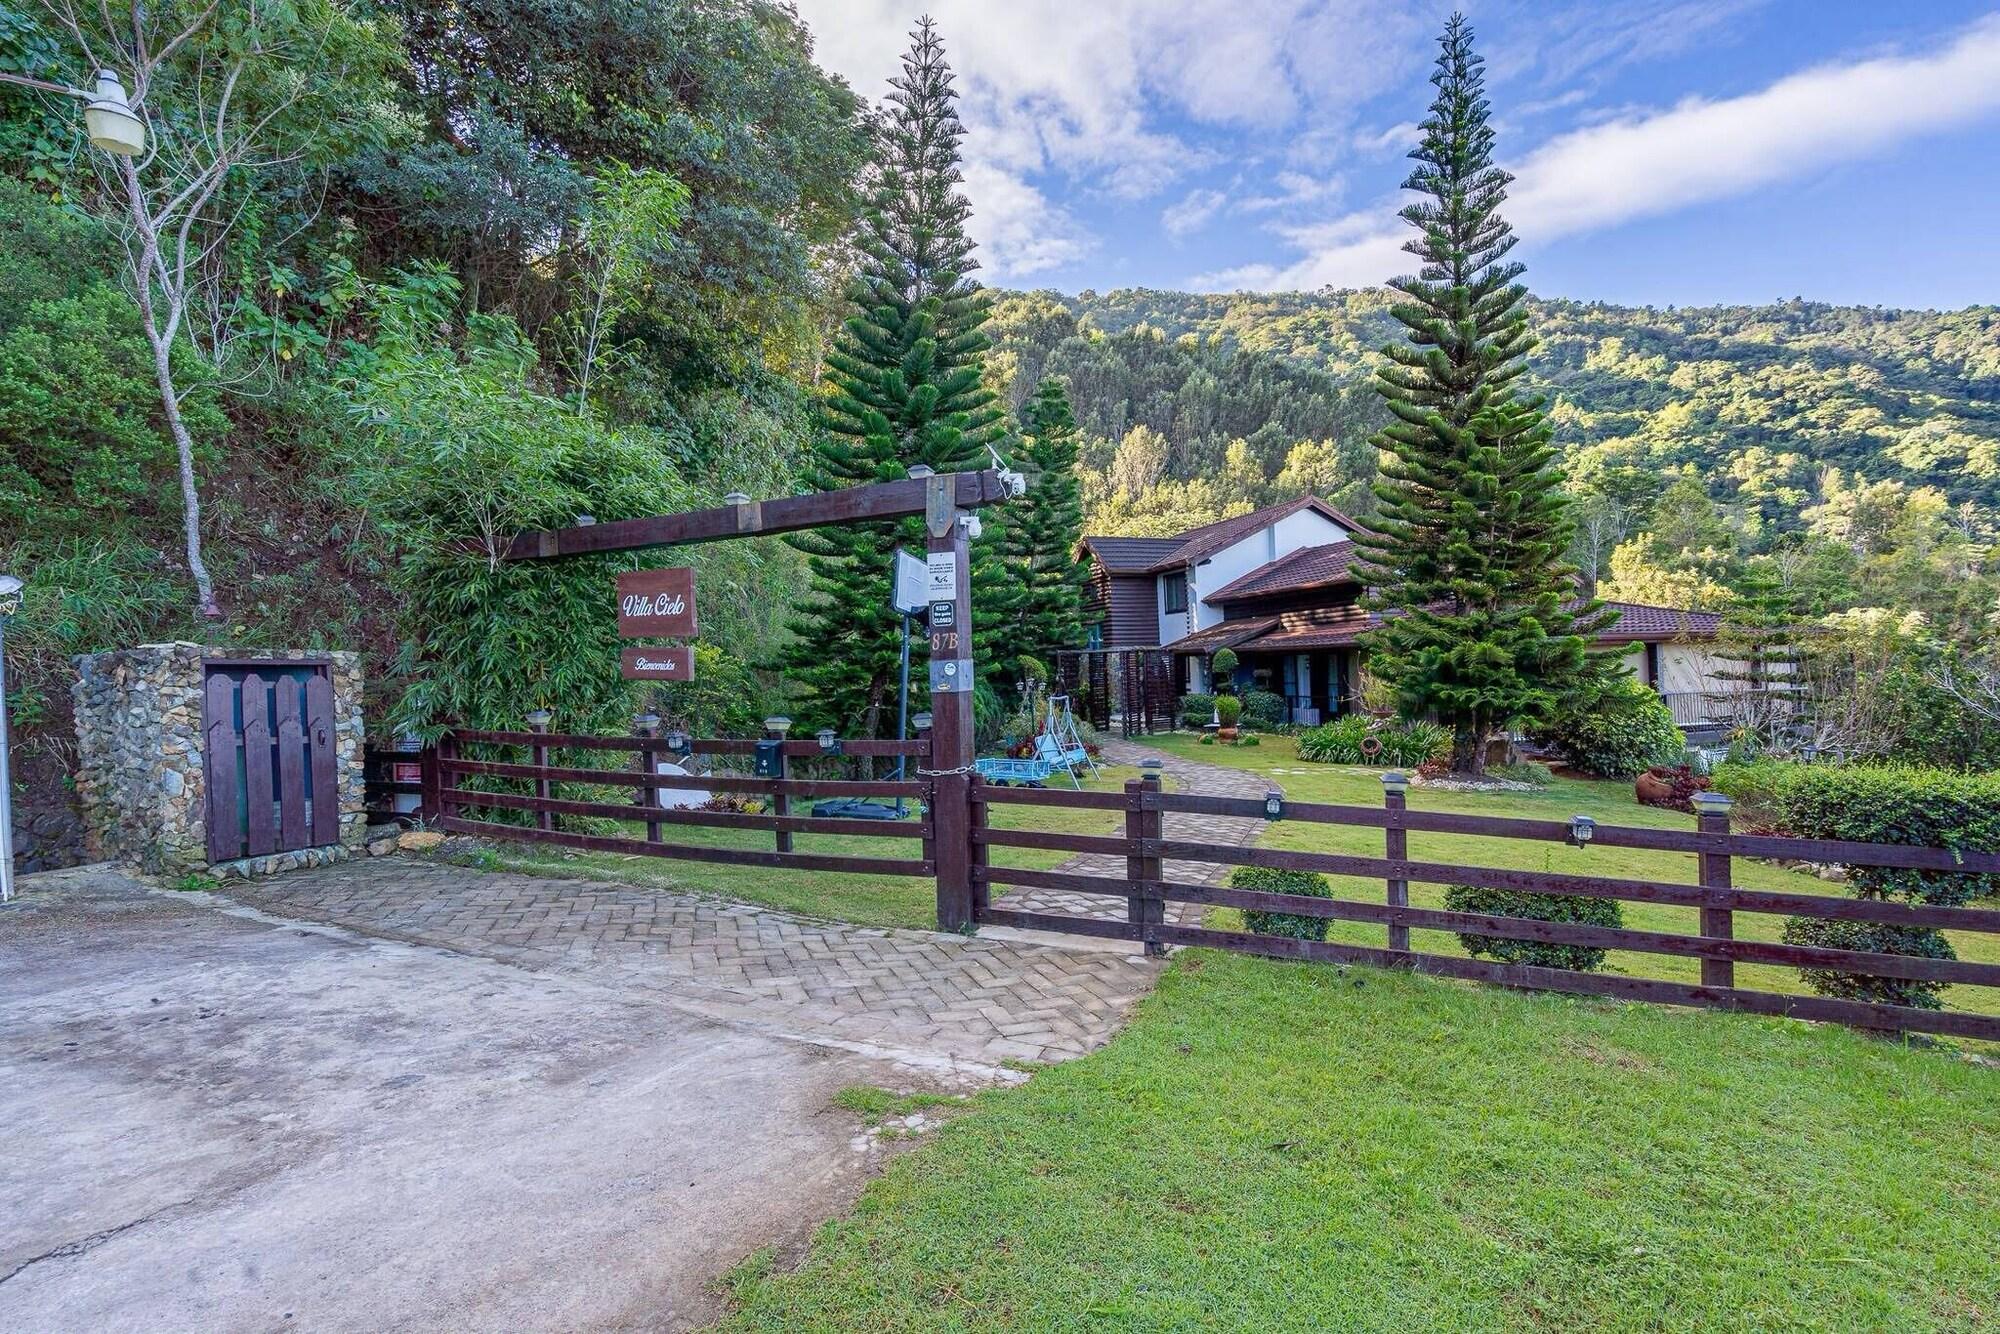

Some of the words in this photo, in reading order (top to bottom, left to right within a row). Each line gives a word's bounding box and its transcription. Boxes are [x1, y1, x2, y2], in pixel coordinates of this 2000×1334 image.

[623, 594, 654, 617] Villa
[654, 593, 685, 616] Cielo
[932, 632, 959, 651] 87B
[635, 657, 675, 671] Bienvenidos
